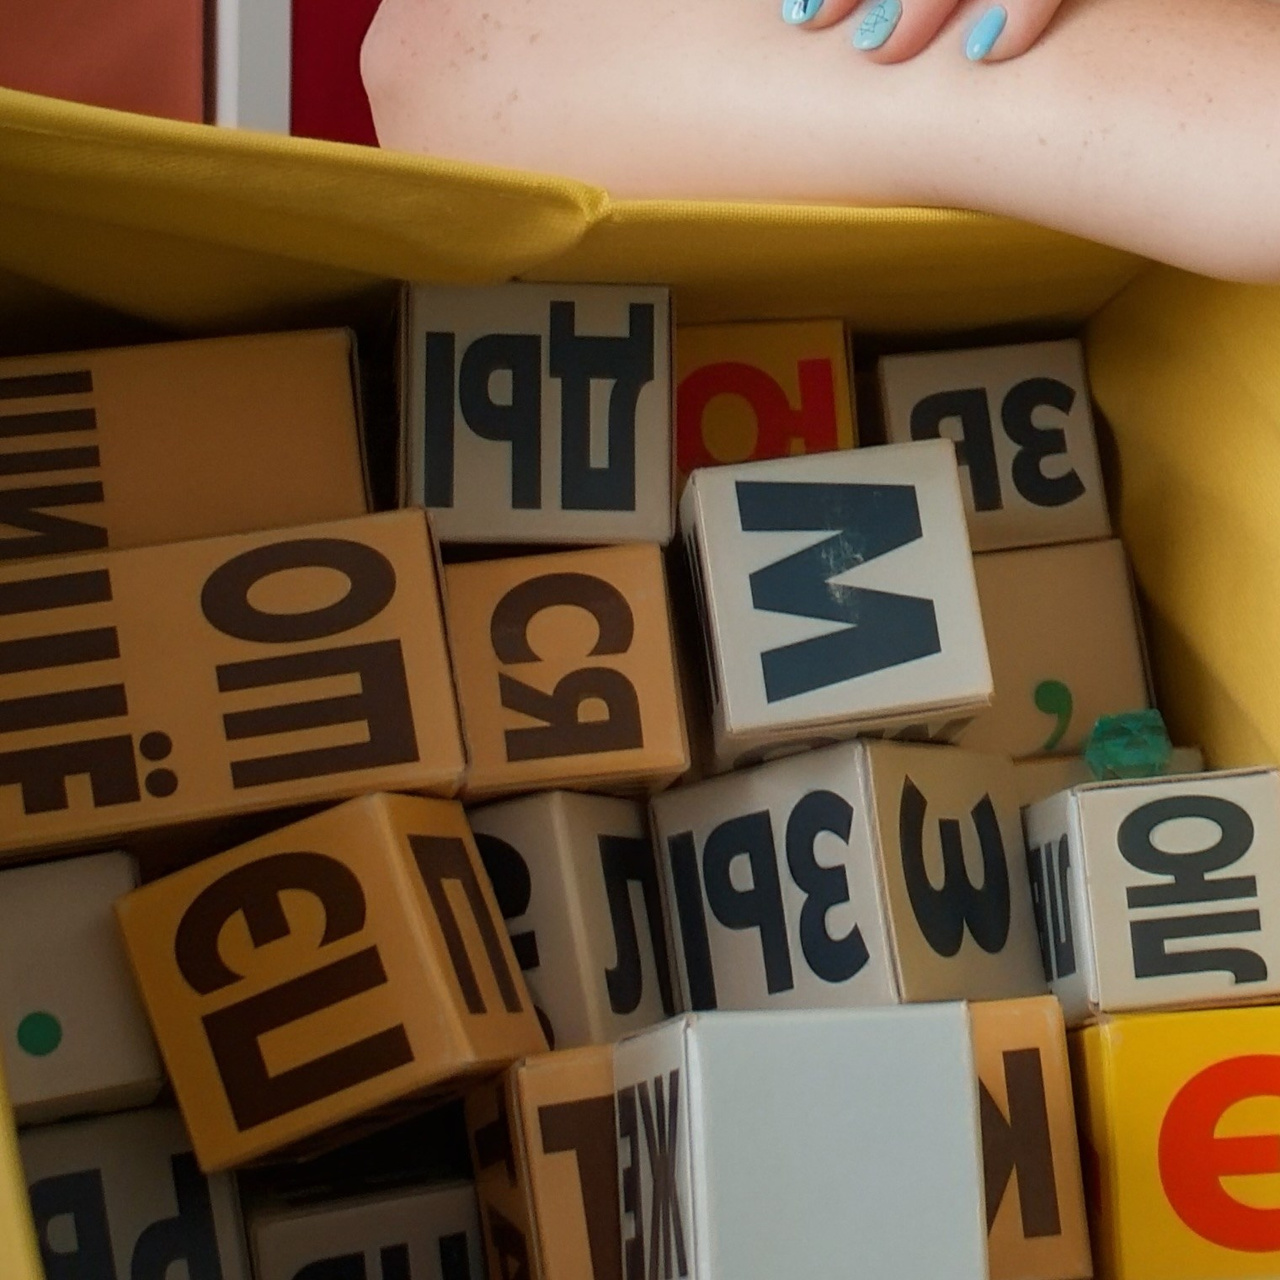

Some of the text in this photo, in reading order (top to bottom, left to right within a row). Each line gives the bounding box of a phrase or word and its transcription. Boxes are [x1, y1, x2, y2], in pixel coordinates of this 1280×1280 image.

[424, 301, 654, 511] ДЫ
[490, 572, 644, 762] СЯ
[667, 789, 870, 1011] ЗЫ
[1117, 794, 1269, 985] ЛЮ
